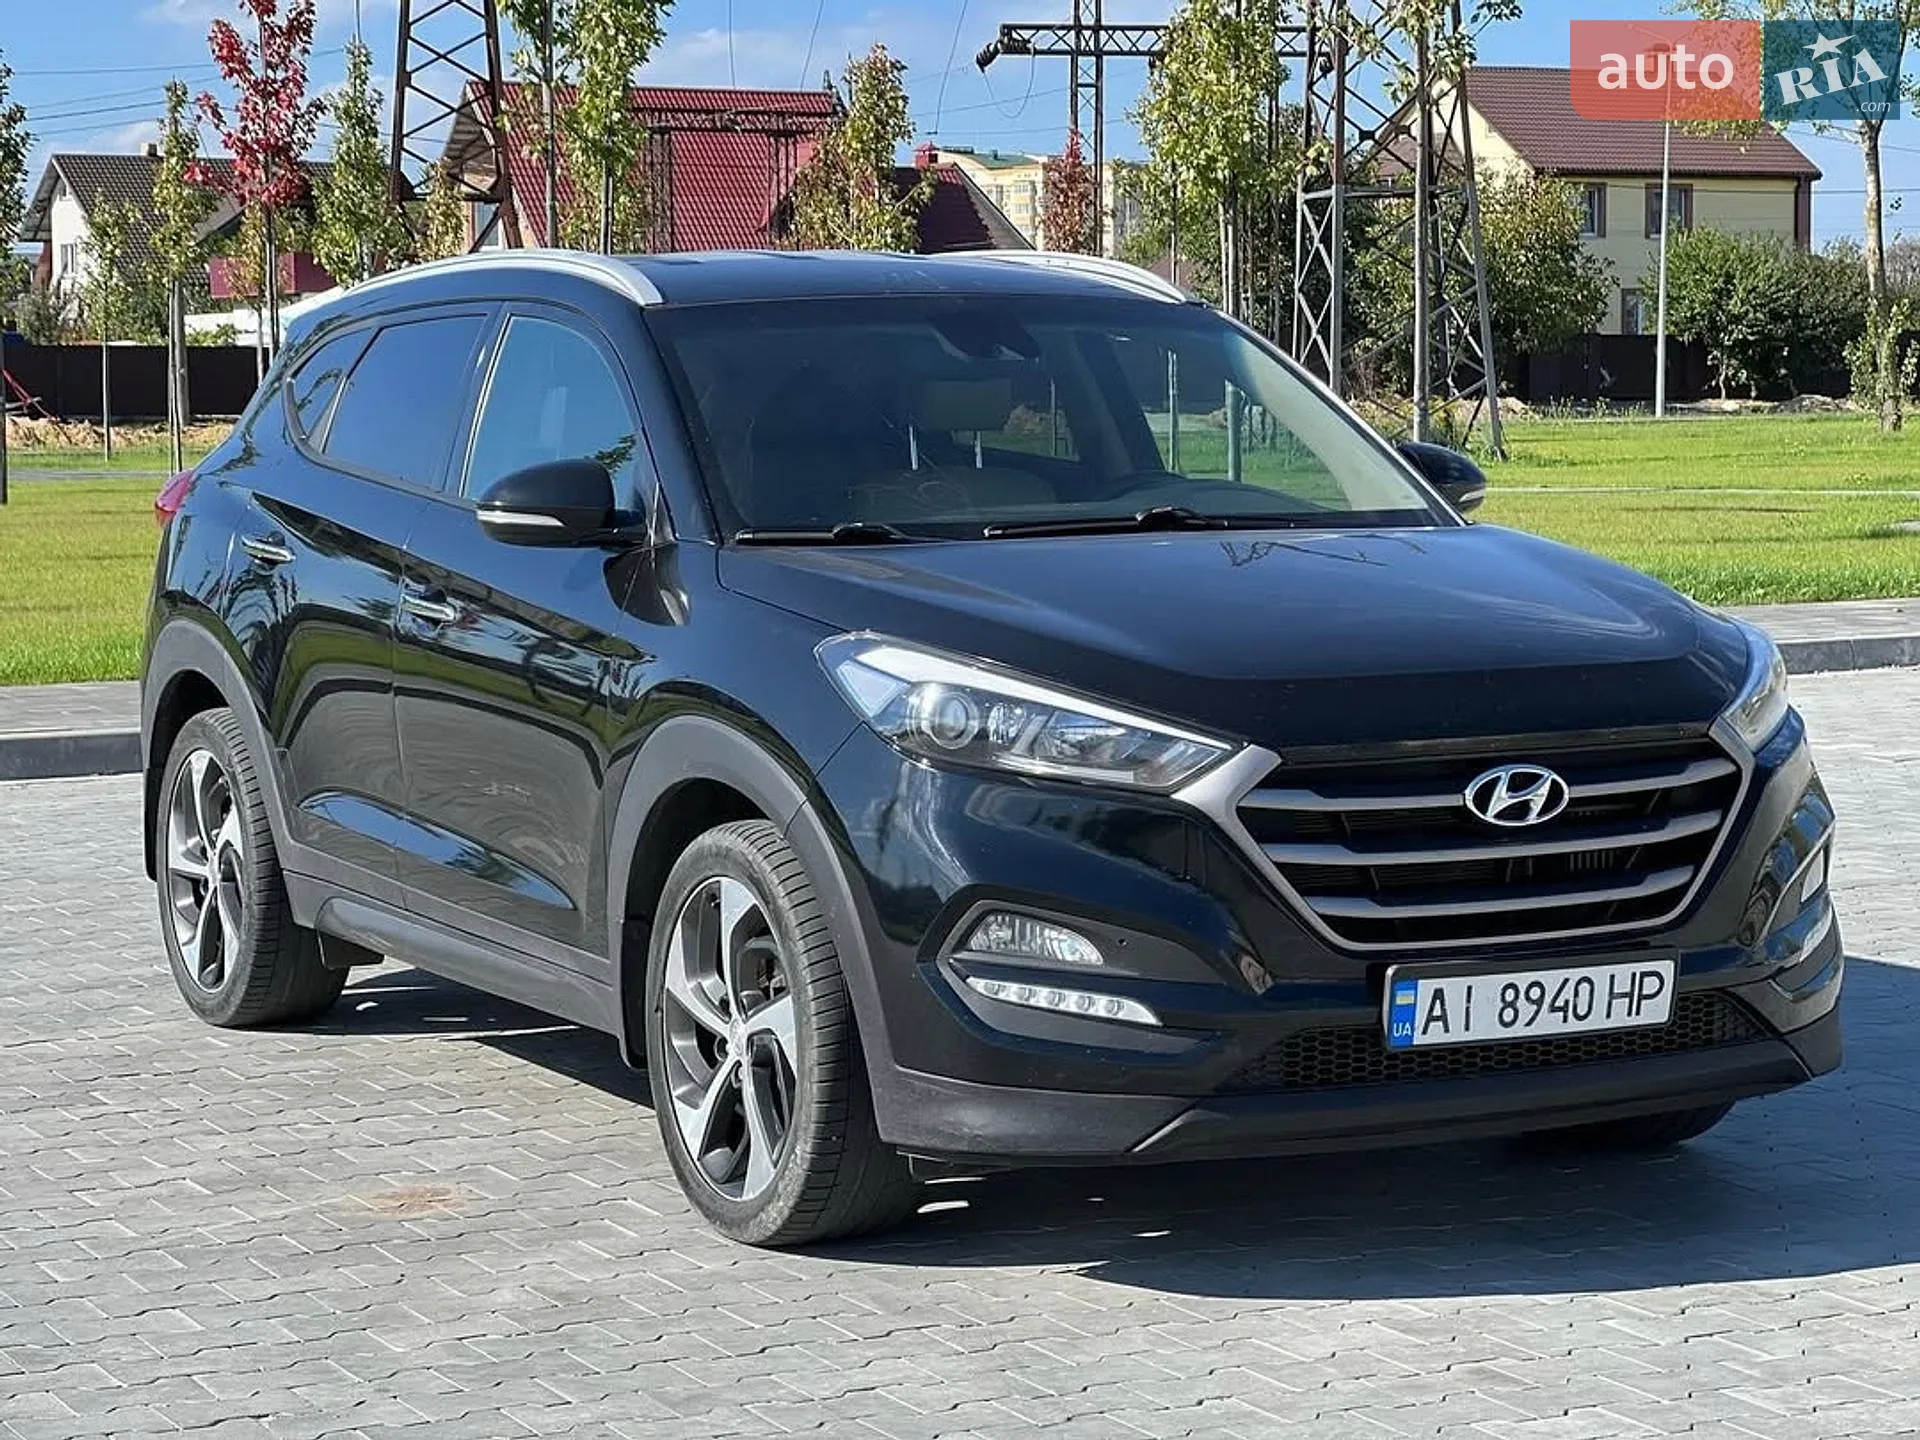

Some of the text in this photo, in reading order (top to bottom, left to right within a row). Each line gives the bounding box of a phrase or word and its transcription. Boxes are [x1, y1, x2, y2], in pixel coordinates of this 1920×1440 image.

[1498, 975, 1595, 1028] 8940
[1605, 970, 1665, 1019] HP
[1392, 1022, 1412, 1038] UA
